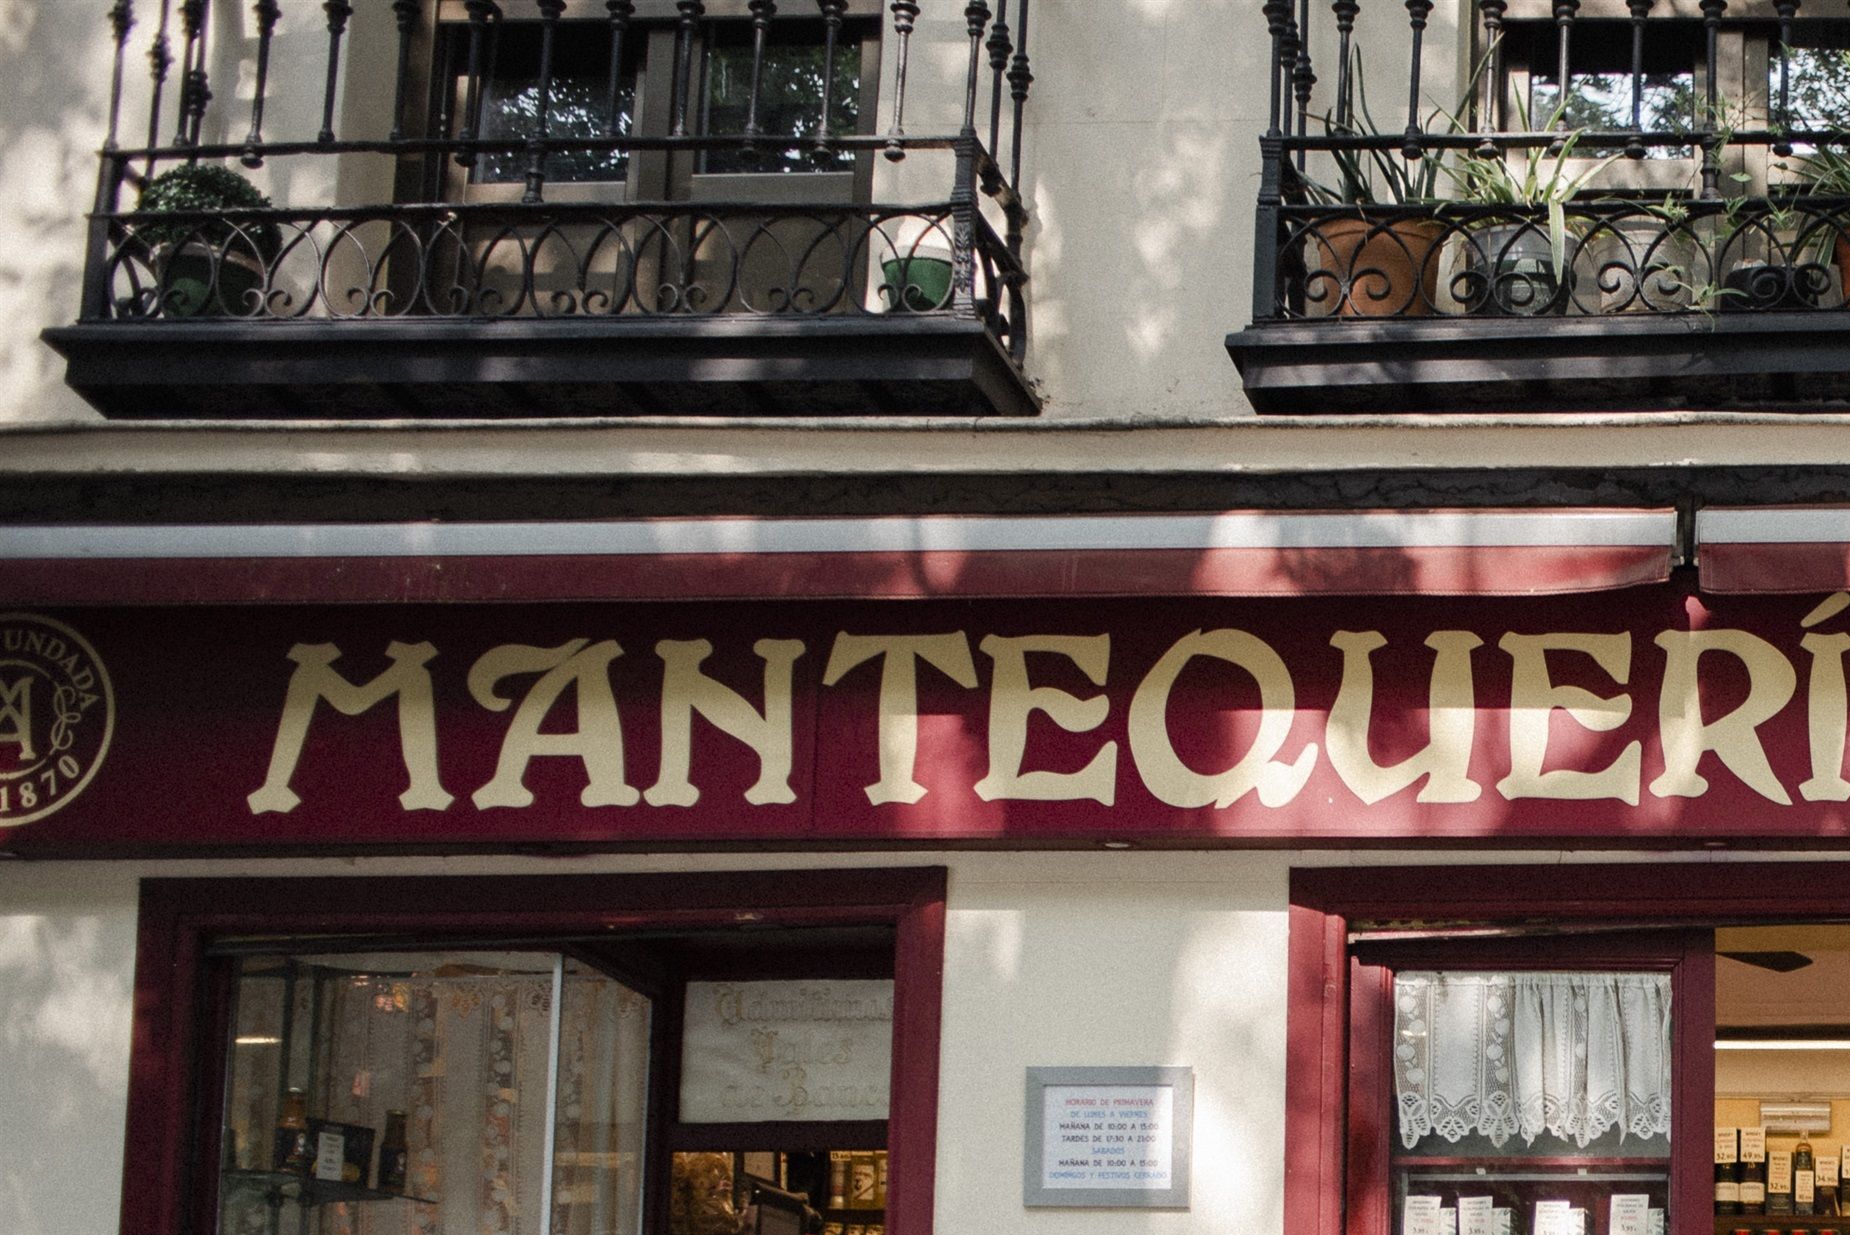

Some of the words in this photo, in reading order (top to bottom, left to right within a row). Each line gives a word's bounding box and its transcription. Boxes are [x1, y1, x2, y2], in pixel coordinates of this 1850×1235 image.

[3, 629, 100, 711] UNDADA
[1059, 1122, 1090, 1130] MAÑANA
[1058, 1159, 1089, 1167] MAÑANA
